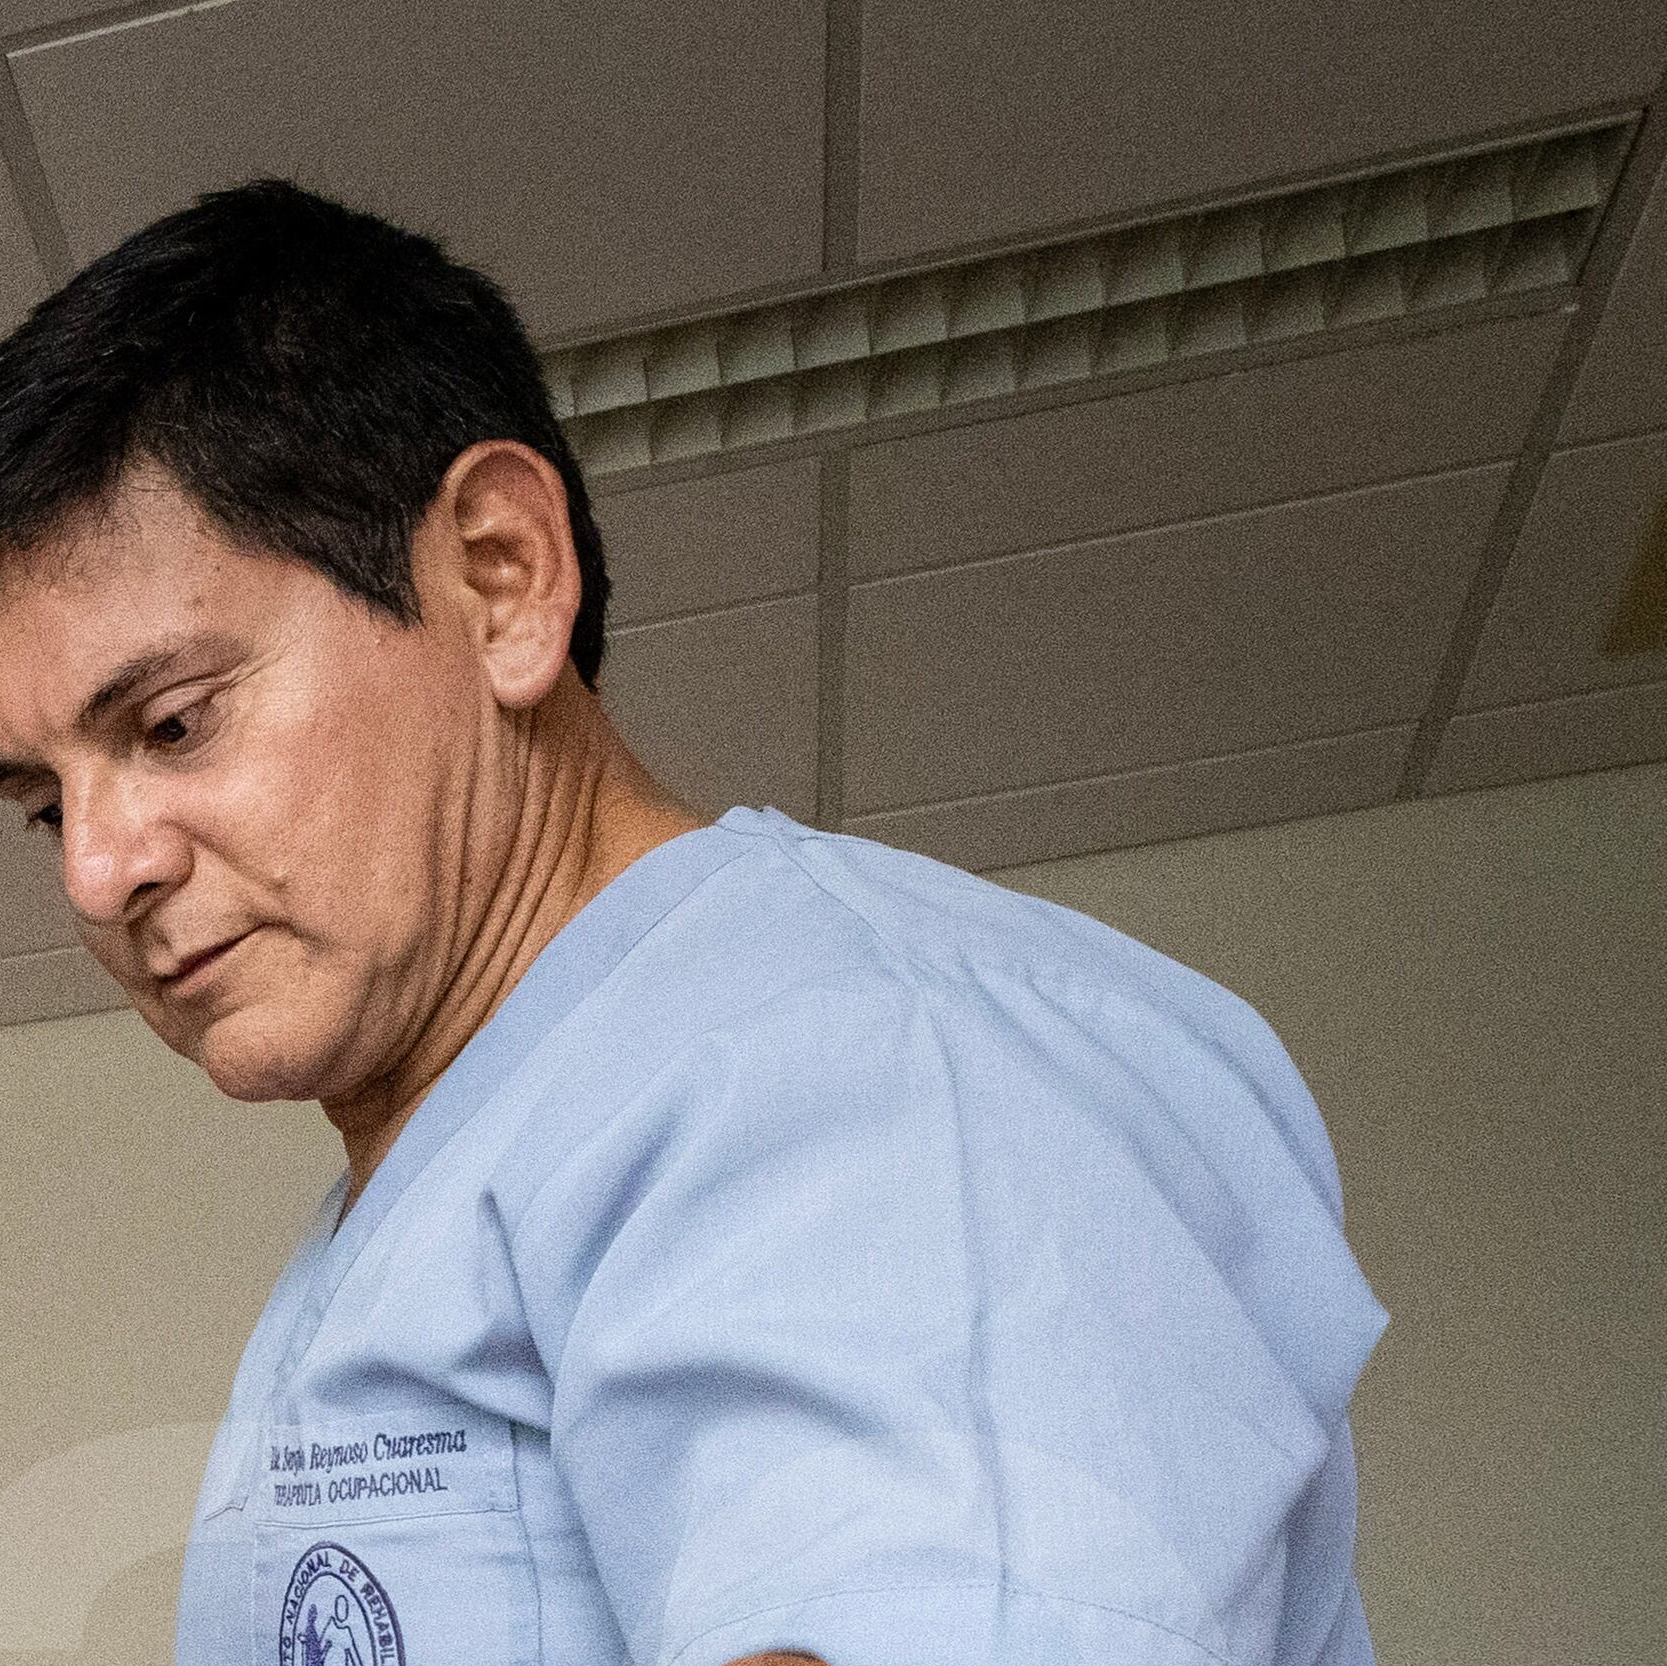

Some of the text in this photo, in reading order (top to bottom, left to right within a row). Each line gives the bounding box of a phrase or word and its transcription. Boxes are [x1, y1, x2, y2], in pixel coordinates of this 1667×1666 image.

[309, 1442, 368, 1474] Reynoso
[373, 1429, 467, 1461] Cuaresma
[328, 1467, 448, 1504] OCUPACIONAL
[286, 1551, 332, 1625] NACIONAL
[339, 1559, 360, 1583] DE
